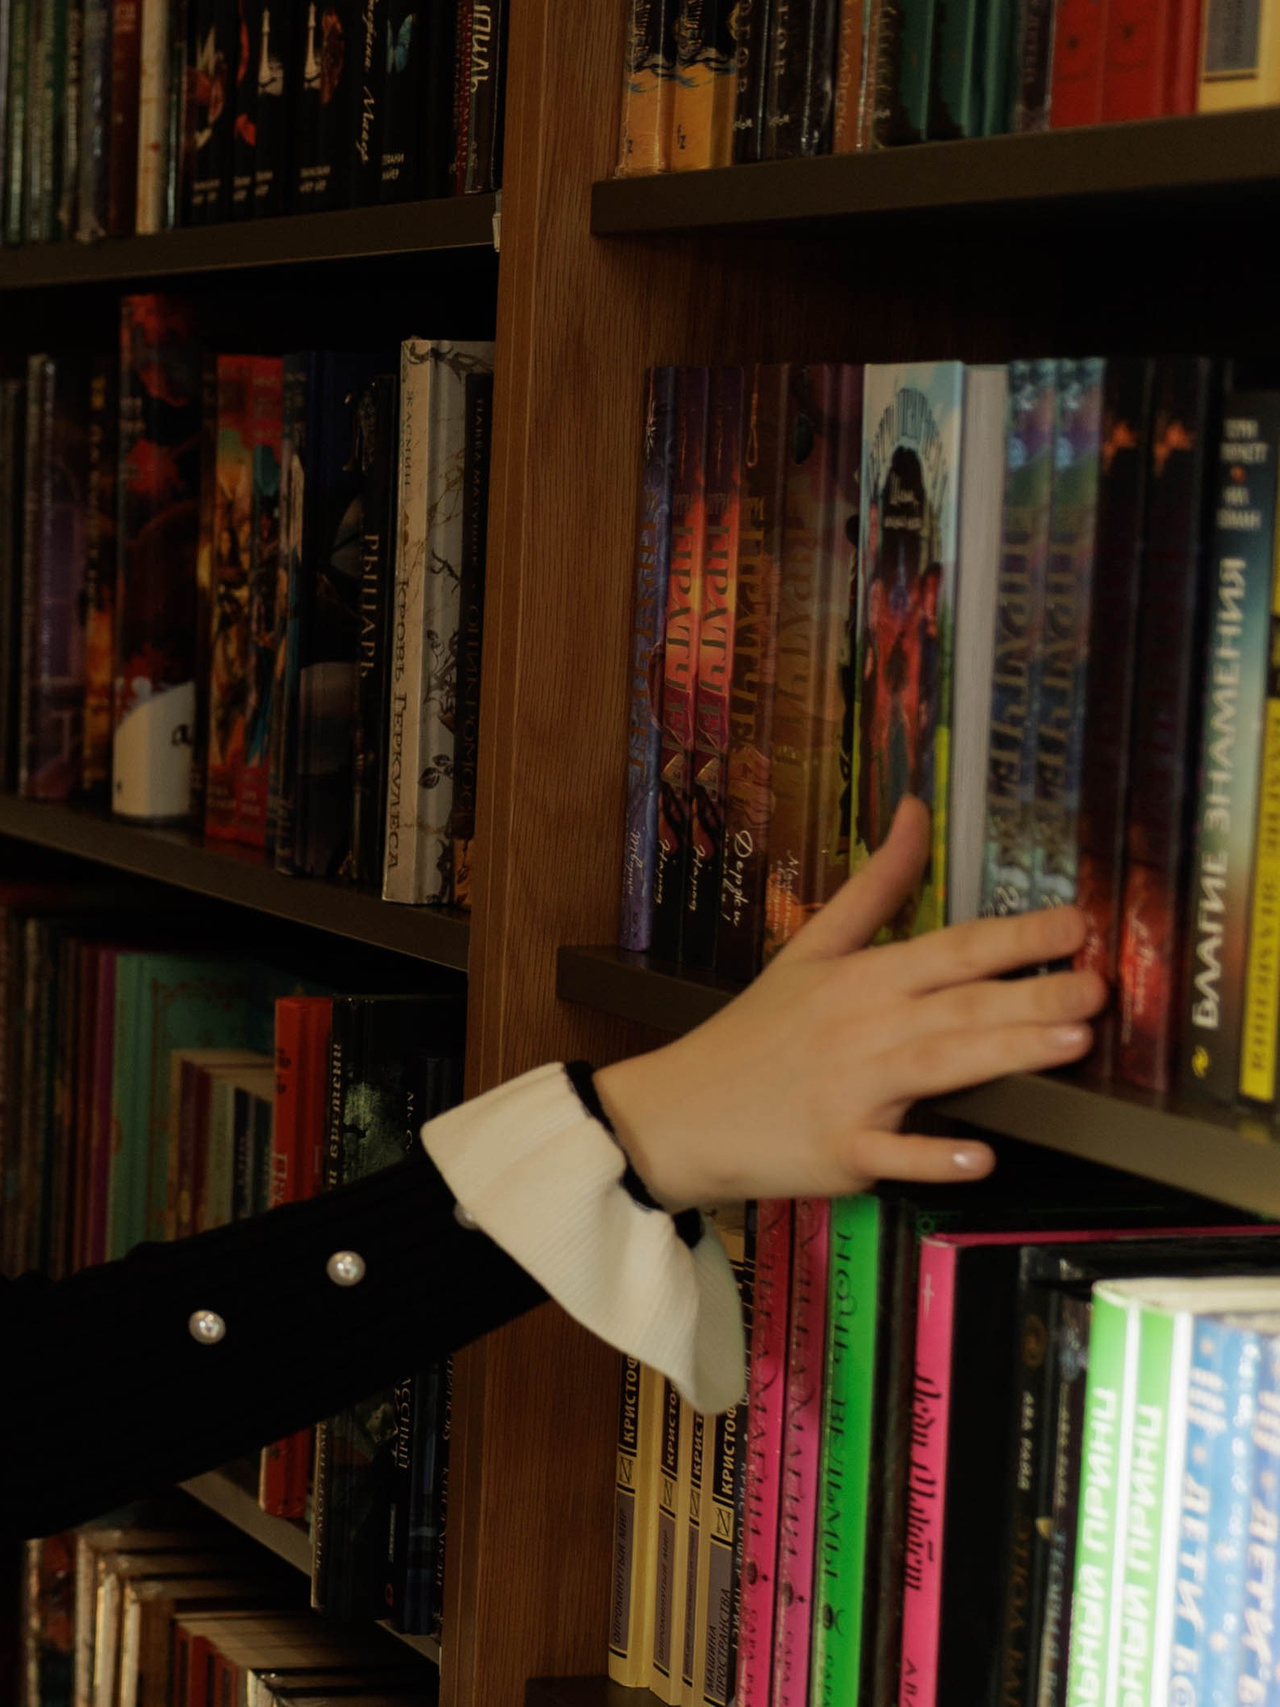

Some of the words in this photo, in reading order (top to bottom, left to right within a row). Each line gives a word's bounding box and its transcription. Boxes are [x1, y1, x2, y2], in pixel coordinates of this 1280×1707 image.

[356, 530, 383, 680] РЫЦАРЬ
[1206, 557, 1247, 831] ЗНАМЕНИЯ
[1191, 848, 1228, 1029] БЛАГИЕ
[618, 1507, 628, 1538] МИР
[662, 1529, 670, 1559] МИР
[1082, 1386, 1119, 1553] ПРИНЦ
[1127, 1404, 1163, 1573] ПРИНЦ
[612, 1542, 627, 1644] ОПРОКИНУТЫЙ
[658, 1562, 668, 1660] ОПРОКИНУТЫЙ
[1175, 1474, 1211, 1634] ДЕТИ
[1242, 1499, 1279, 1667] ДЕТИ
[705, 1626, 717, 1691] МАШИНА
[715, 1589, 730, 1696] ПРОСТРАНСТВА
